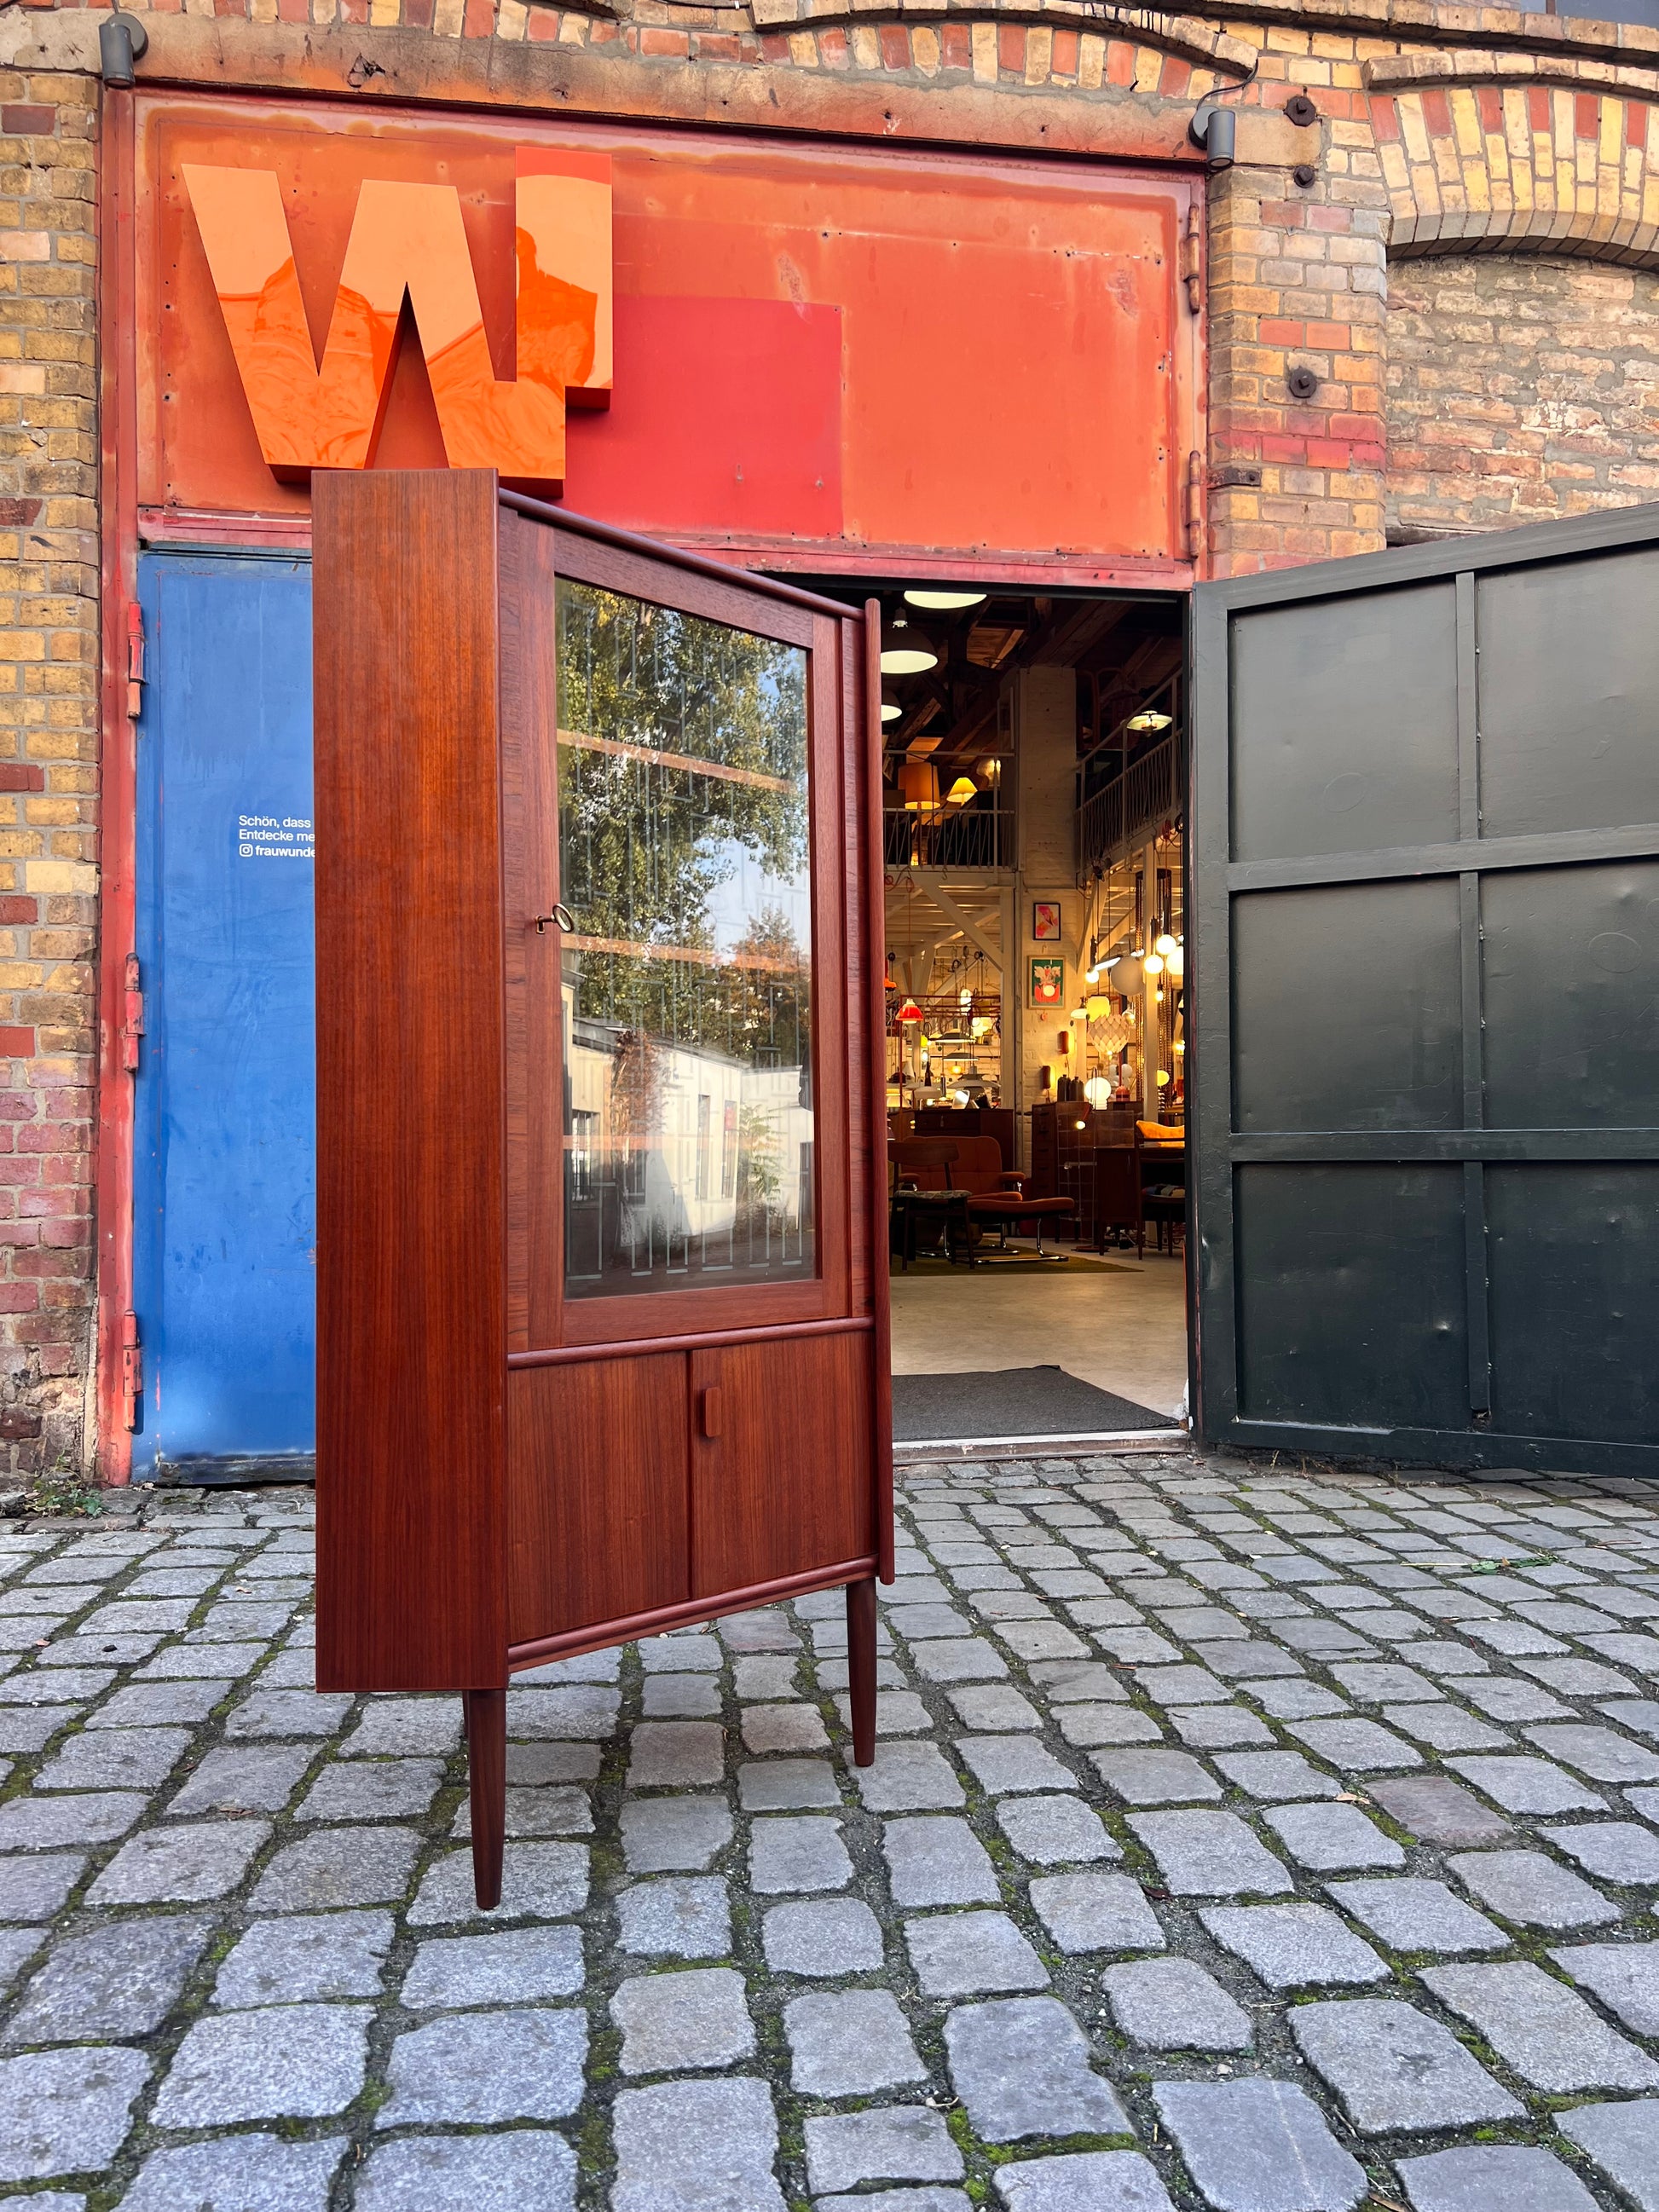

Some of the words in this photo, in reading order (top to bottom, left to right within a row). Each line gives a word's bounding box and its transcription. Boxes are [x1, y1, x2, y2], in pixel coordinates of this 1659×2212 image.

[239, 815, 280, 829] Schön,
[282, 817, 311, 828] dass
[239, 829, 294, 841] Entdecke
